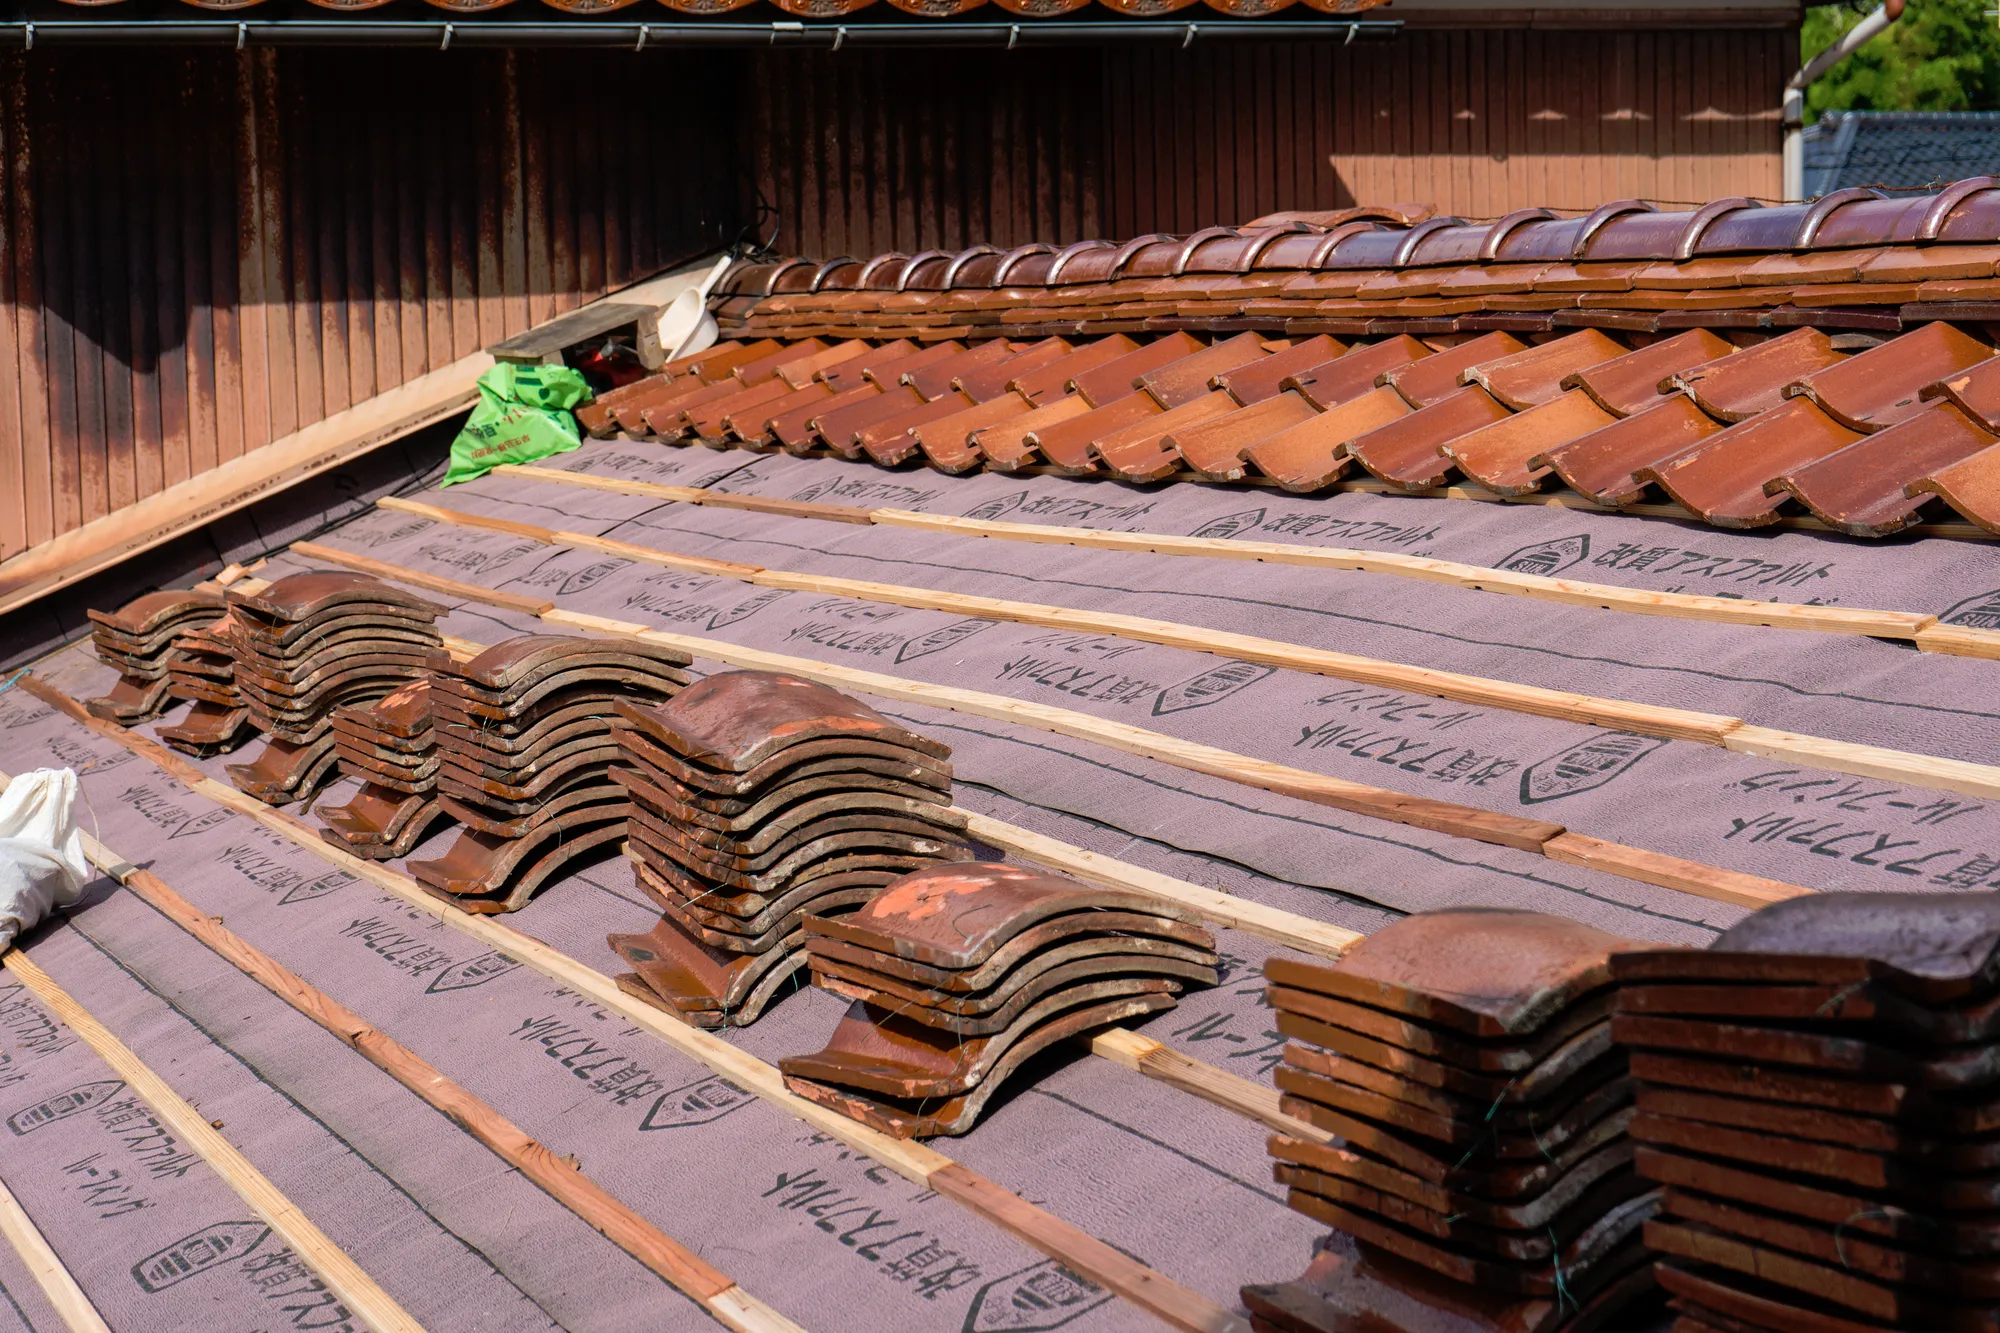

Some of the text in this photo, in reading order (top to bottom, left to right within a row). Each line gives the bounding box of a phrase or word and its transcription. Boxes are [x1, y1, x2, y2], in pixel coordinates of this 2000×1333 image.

[834, 480, 946, 506] 改質アスファルト
[1020, 496, 1157, 521] 改質アスファルト
[1262, 513, 1441, 547] 改質アスファルト
[1592, 543, 1836, 587] 改質アスファルト
[782, 620, 906, 655] 改質アスファルト
[995, 654, 1160, 703] 改質アスファルト
[1303, 689, 1484, 731] ルーフィング
[1293, 720, 1518, 787] 改質アスファルト
[1722, 770, 1984, 825] ルーフィング
[215, 843, 302, 893] 改質アスファルト
[1724, 812, 2000, 889] 質アスファルト
[339, 916, 452, 976] 改質アスファルト
[509, 1015, 664, 1105] 改質アスファルト
[96, 1097, 206, 1179] 改質アスファルト
[61, 1152, 157, 1218] ルーフィング
[761, 1168, 981, 1301] 改質アスファルト
